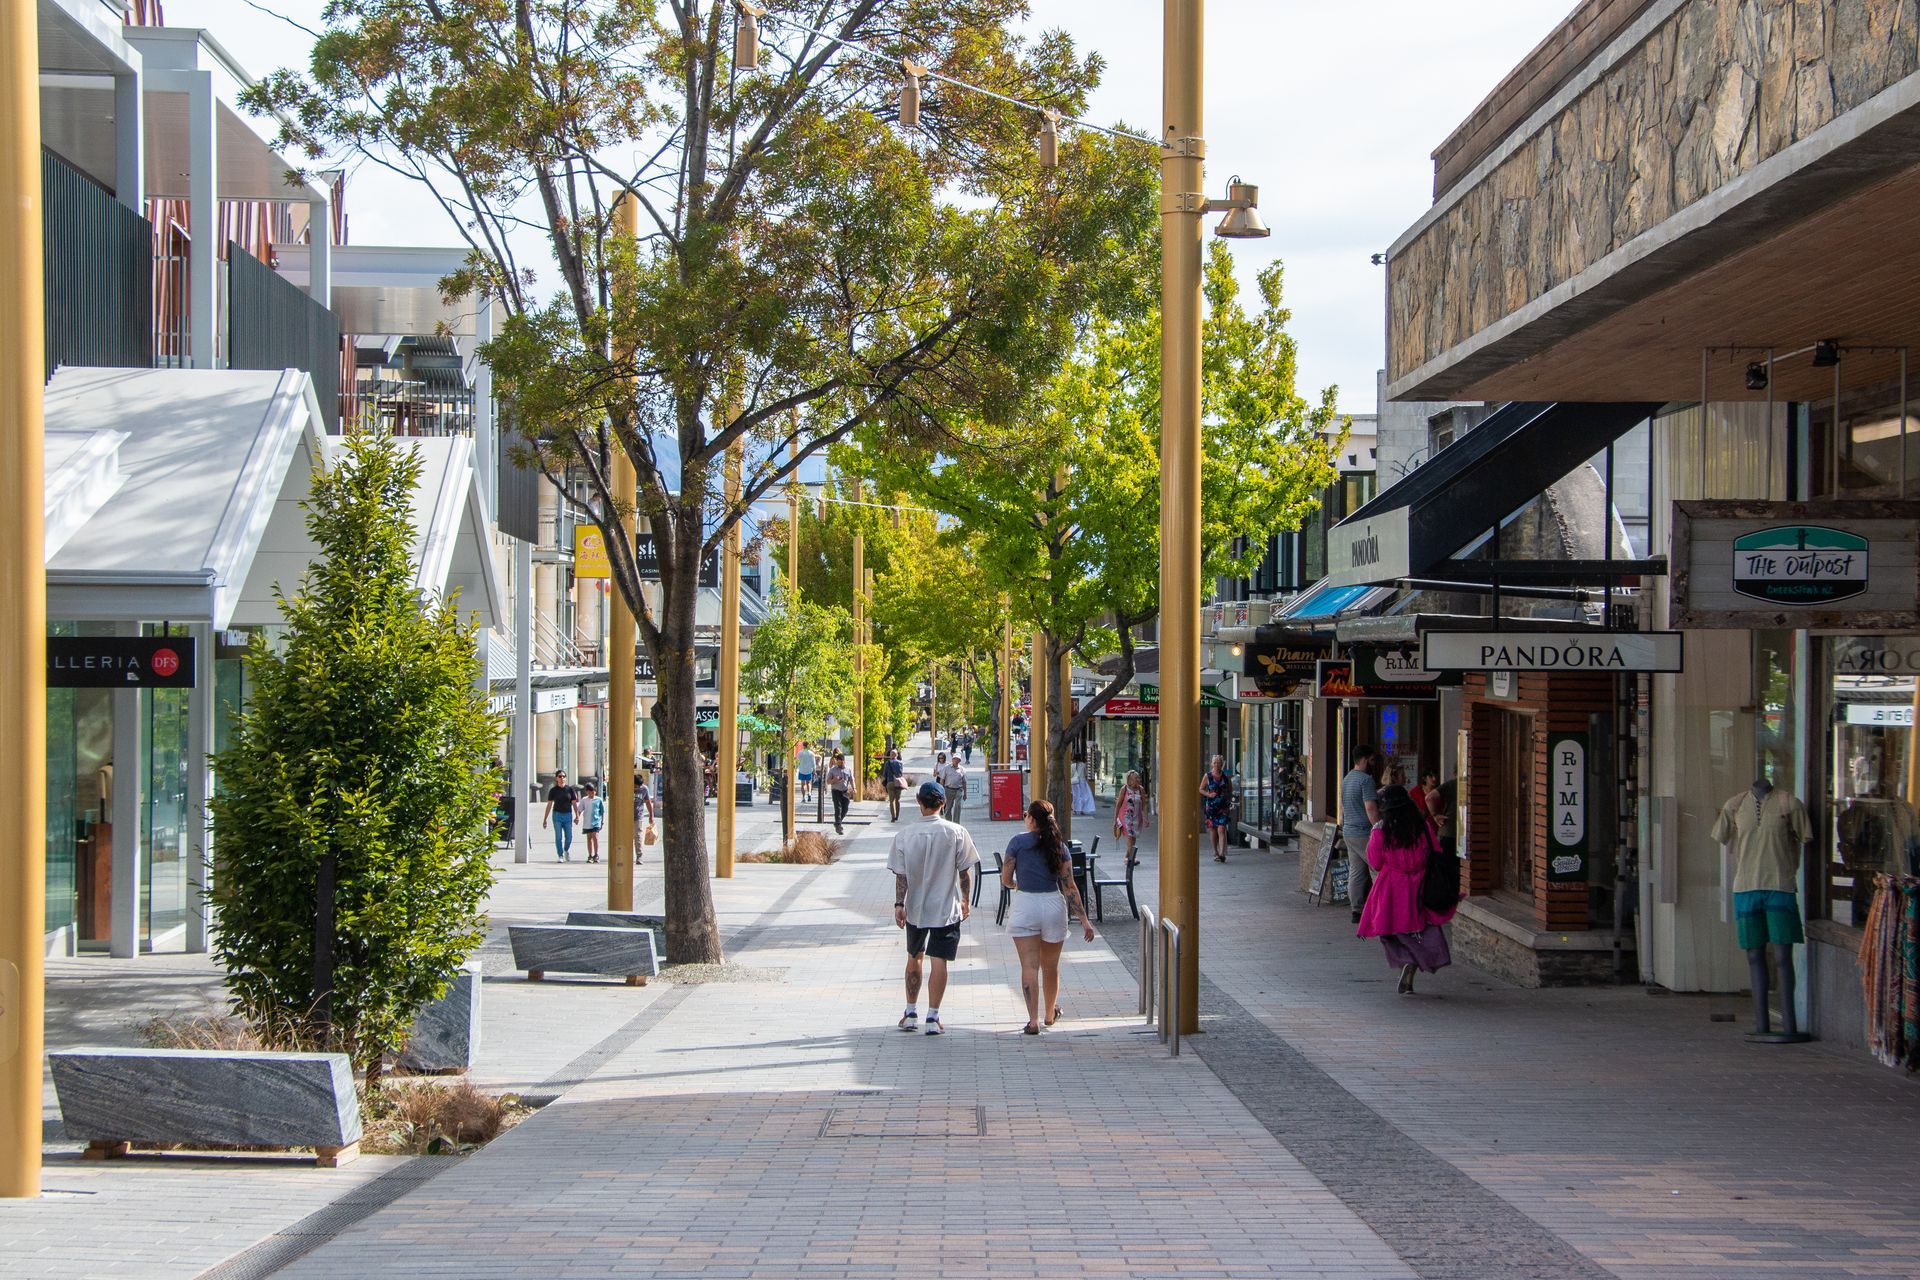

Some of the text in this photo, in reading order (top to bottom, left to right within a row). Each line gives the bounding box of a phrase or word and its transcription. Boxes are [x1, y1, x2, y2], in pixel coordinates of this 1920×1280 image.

[1352, 535, 1380, 568] PANDORA
[1746, 552, 1855, 578] THE Outpost
[46, 656, 177, 669] LLERIA DFS
[1276, 647, 1316, 661] Tham
[1481, 645, 1625, 667] PANDORA
[1560, 751, 1578, 826] RIMA
